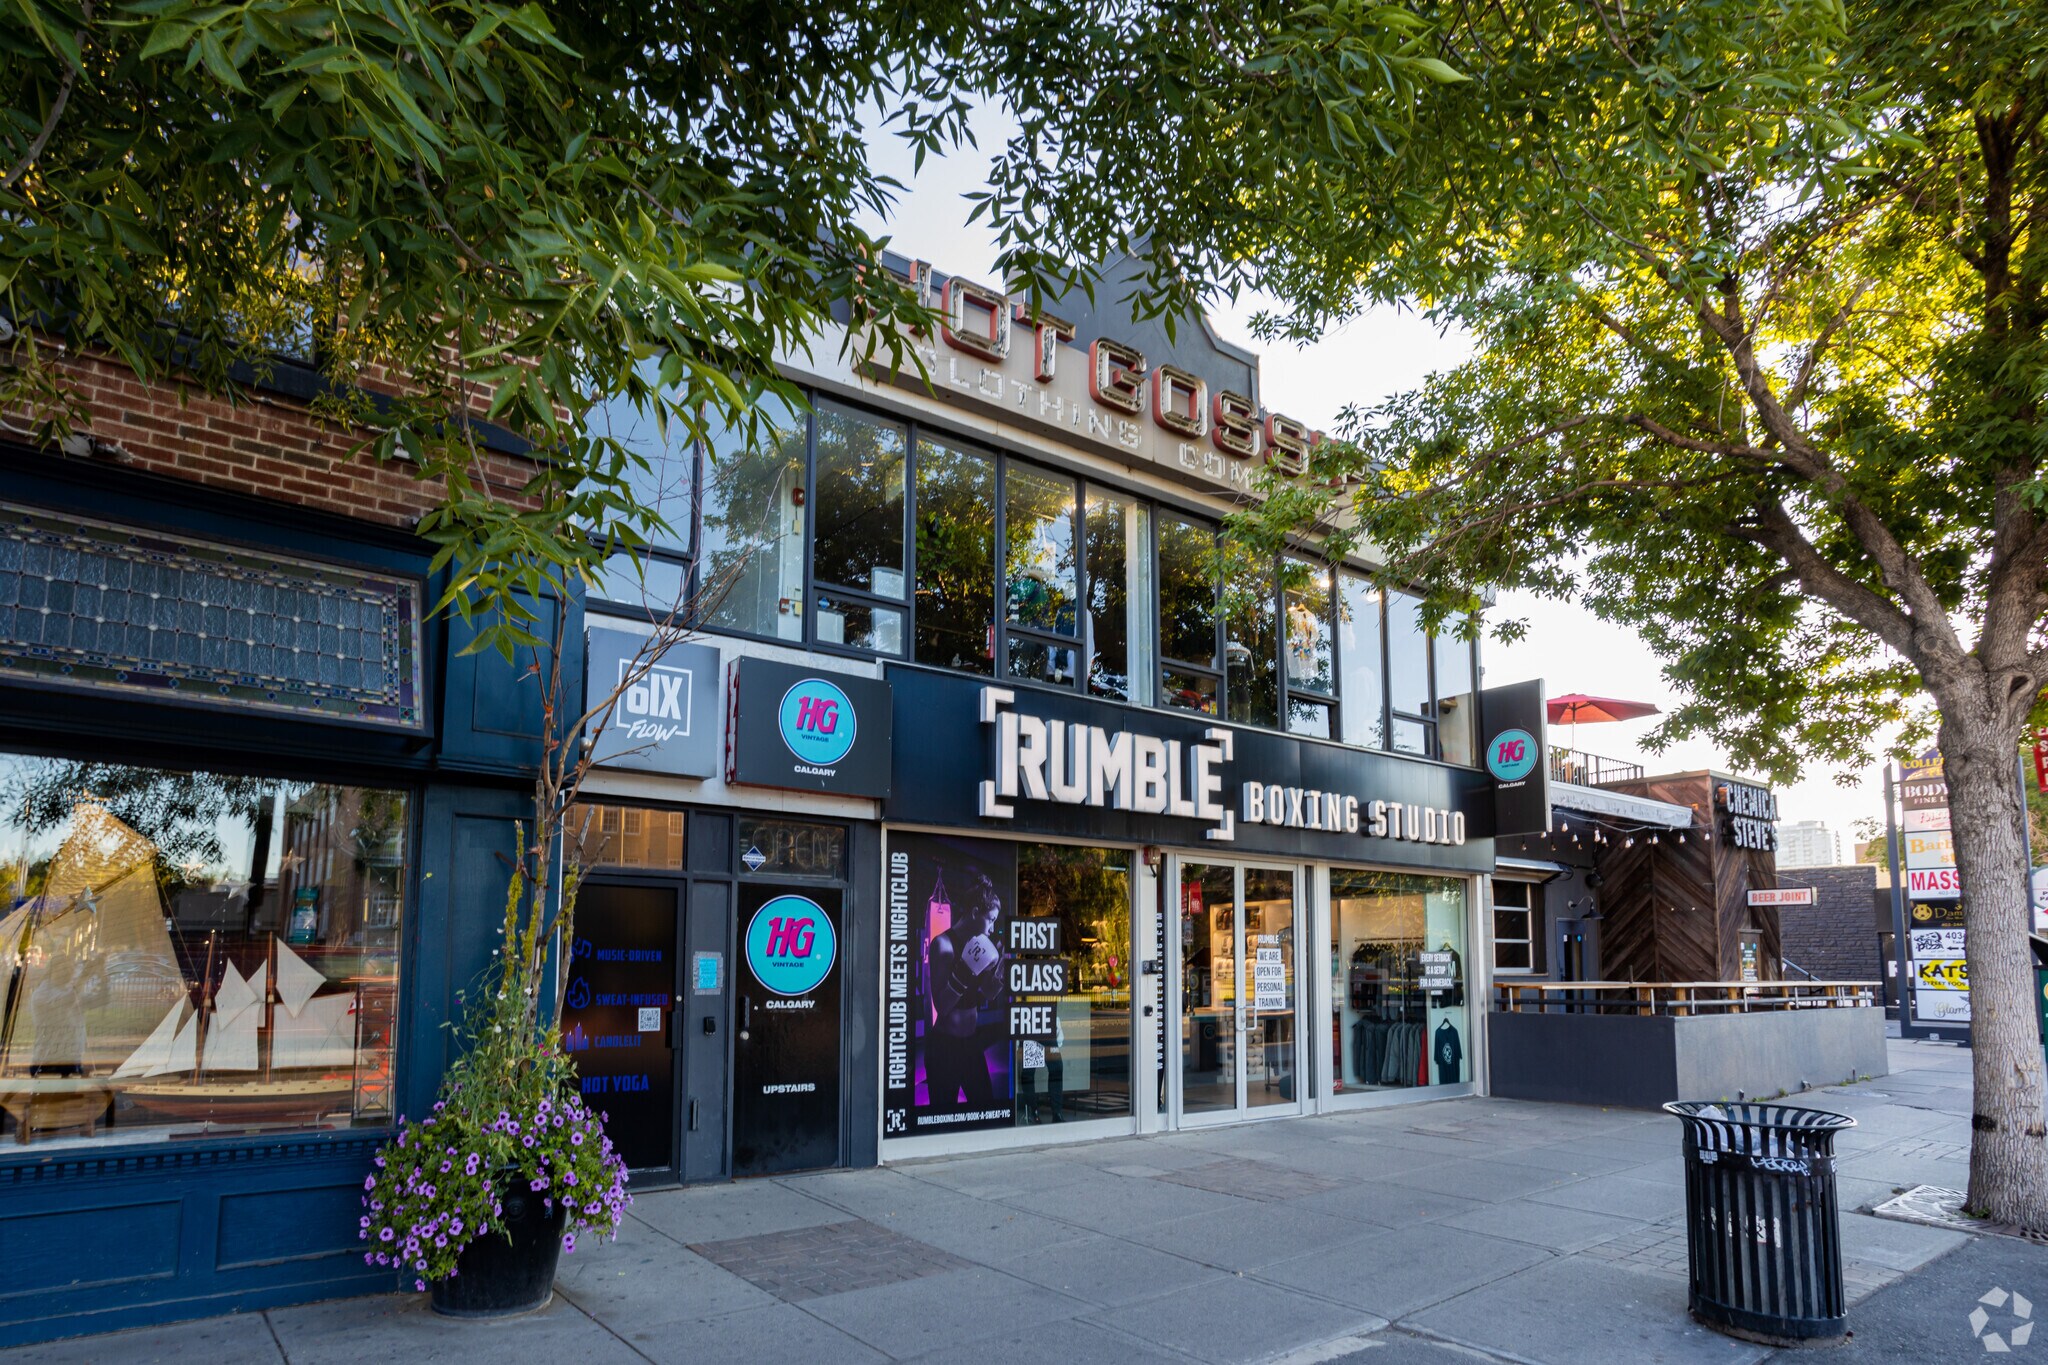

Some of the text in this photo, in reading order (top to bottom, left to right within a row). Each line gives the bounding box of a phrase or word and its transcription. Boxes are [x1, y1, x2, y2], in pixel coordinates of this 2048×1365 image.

[796, 695, 839, 735] HG
[626, 719, 679, 741] FLOW
[801, 733, 830, 743] VINTAGE
[1497, 739, 1525, 764] HG
[794, 764, 836, 777] CALGARY
[995, 711, 1224, 821] RUMBLE
[1498, 781, 1527, 789] CALGARY
[1243, 781, 1466, 846] BOXING STUDIO
[1734, 816, 1778, 851] STEVE'S
[1752, 891, 1807, 903] BEER JOINT
[766, 917, 816, 959] HG
[1010, 920, 1058, 950] FIRST
[597, 949, 662, 962] MUSIC-DRIVEN
[1259, 951, 1279, 961] WE ARE
[888, 851, 909, 1090] FIGHTCLUB MEETS NIGHTCLUB
[1010, 963, 1063, 992] CLASS
[1257, 966, 1282, 977] OPEN FOR
[1257, 981, 1284, 992] PERSONAL
[765, 1000, 816, 1010] CALGARY
[1258, 997, 1283, 1008] TRAINING
[1010, 1006, 1052, 1035] FREE
[581, 1073, 649, 1094] HOT YOGA
[763, 1083, 816, 1094] UPSTAIRS
[917, 1109, 1011, 1126] RUMBLEBOXING.COM/BOOK-A-SWEAT-YYC
